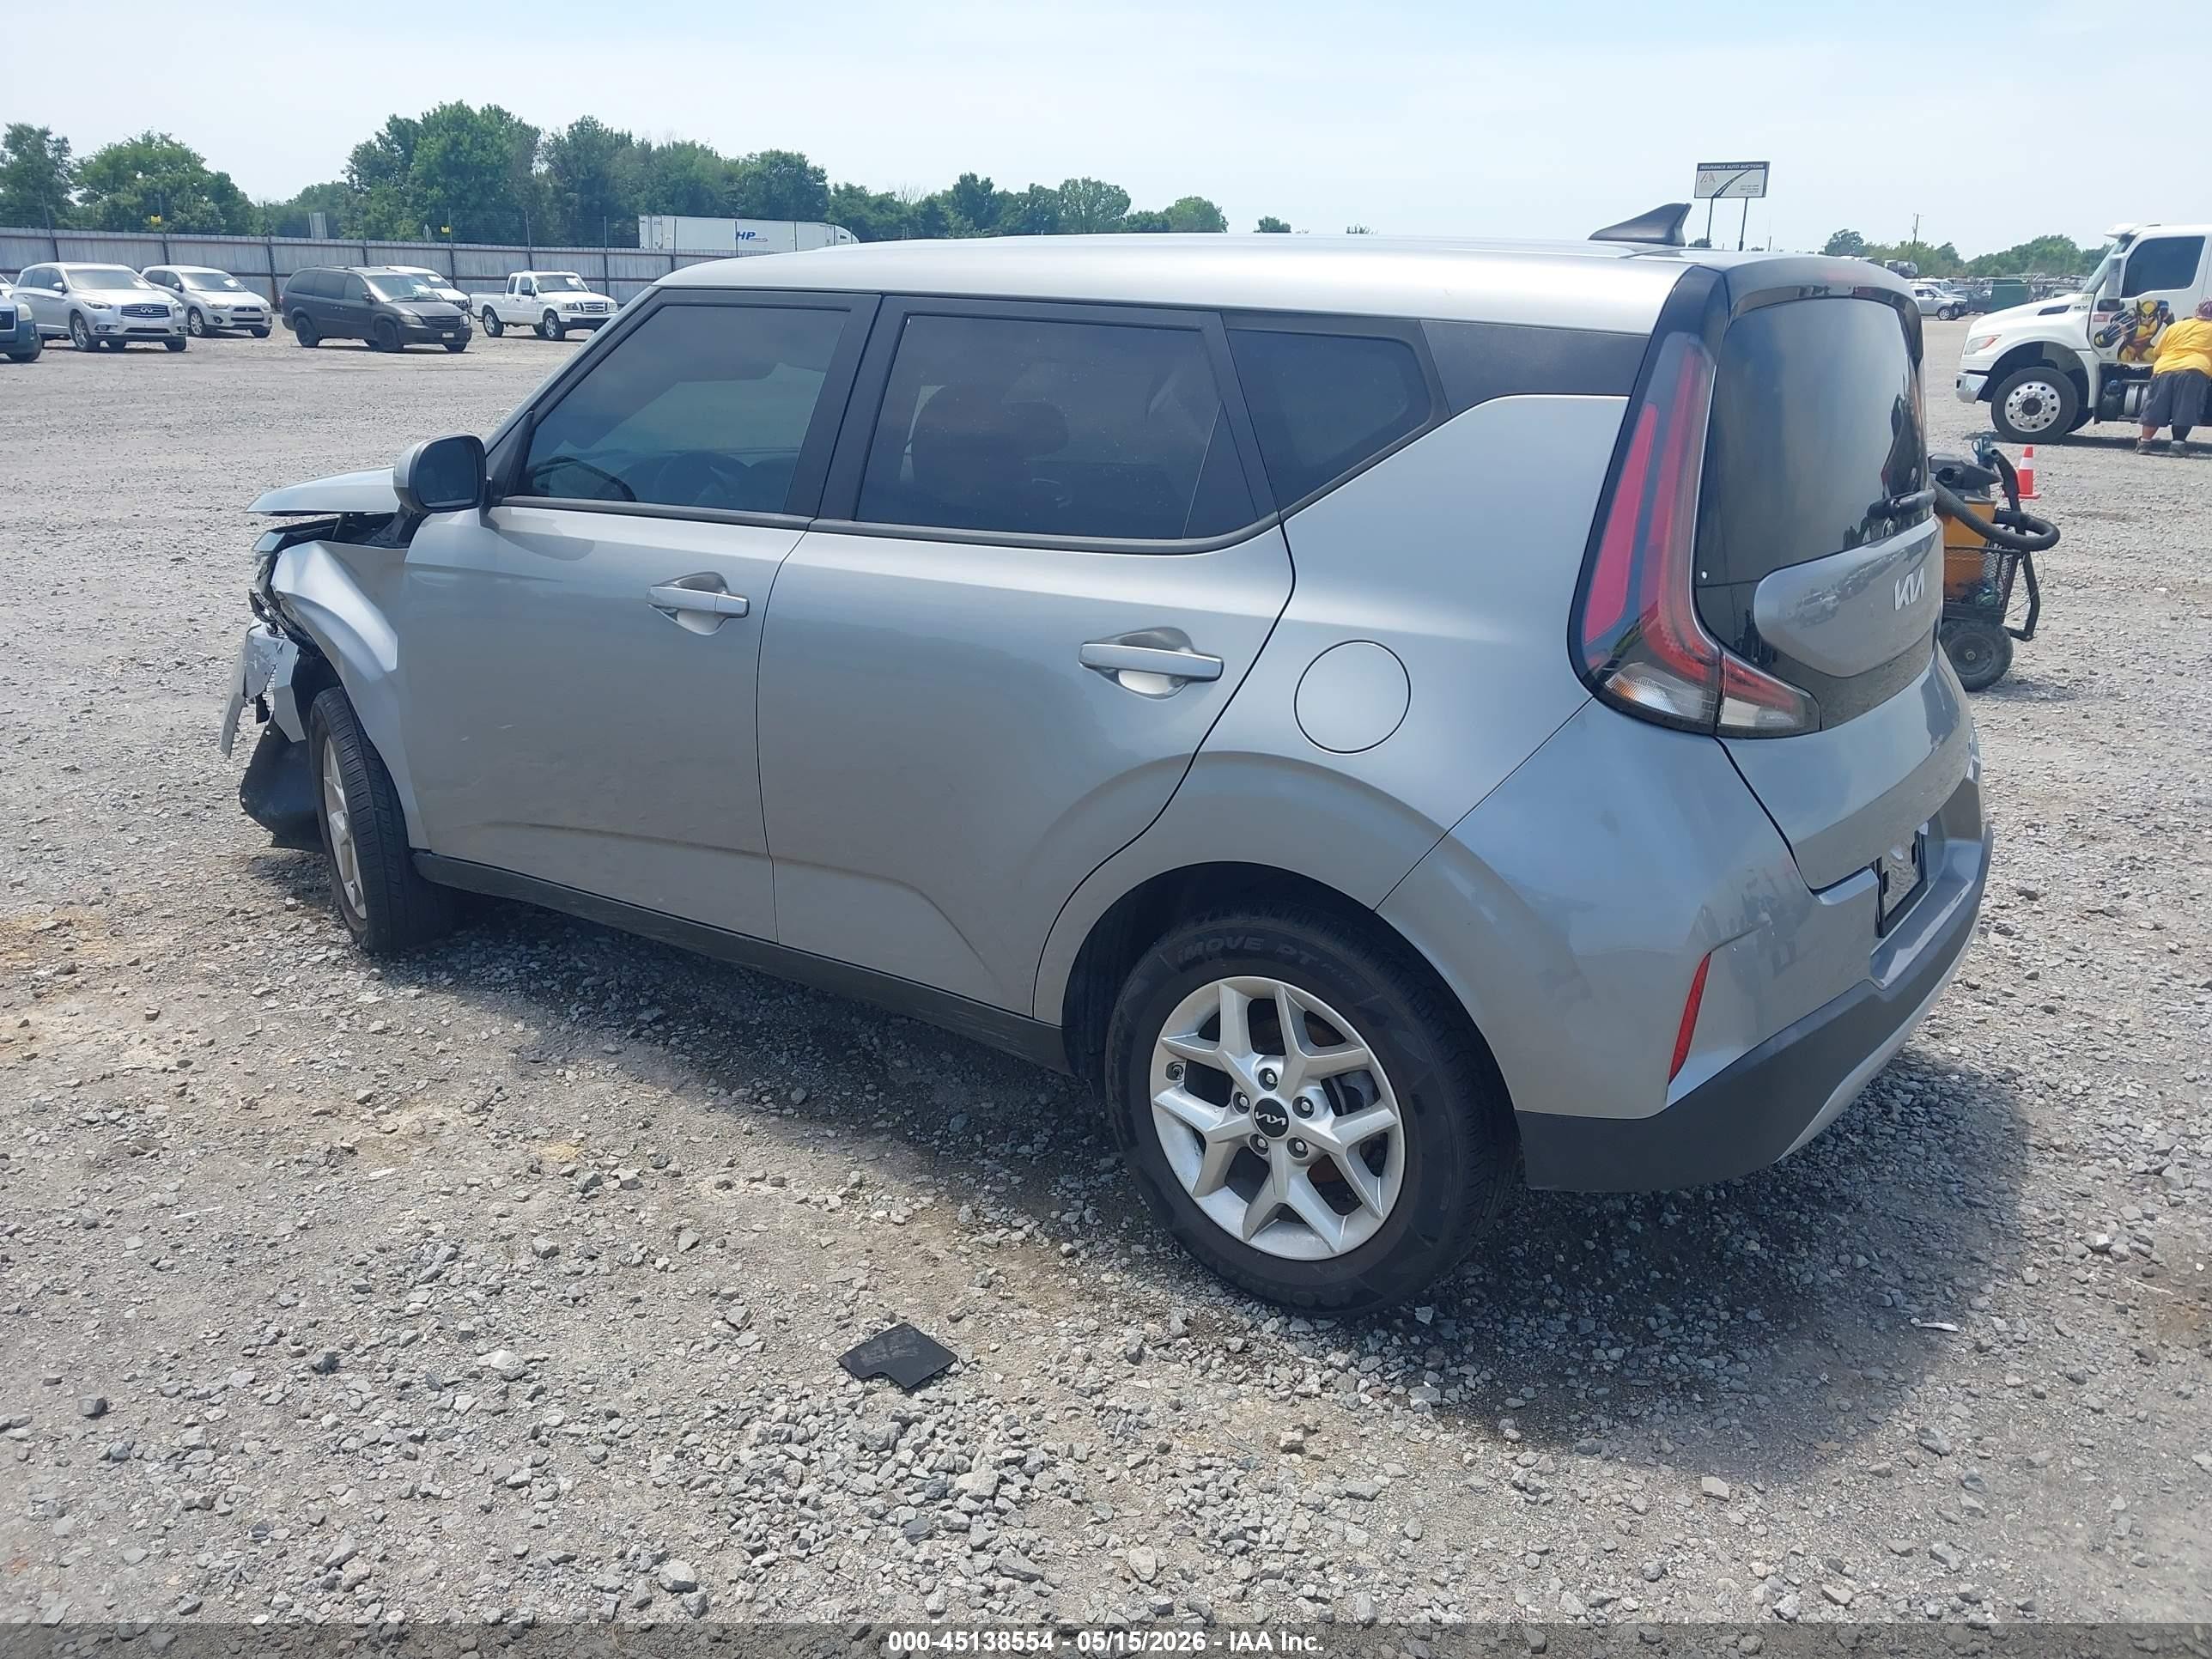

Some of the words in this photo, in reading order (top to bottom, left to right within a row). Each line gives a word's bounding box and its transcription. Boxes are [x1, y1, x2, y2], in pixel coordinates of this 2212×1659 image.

[735, 231, 756, 240] HP
[1894, 567, 1925, 611] KIA
[1274, 941, 1320, 966] PT
